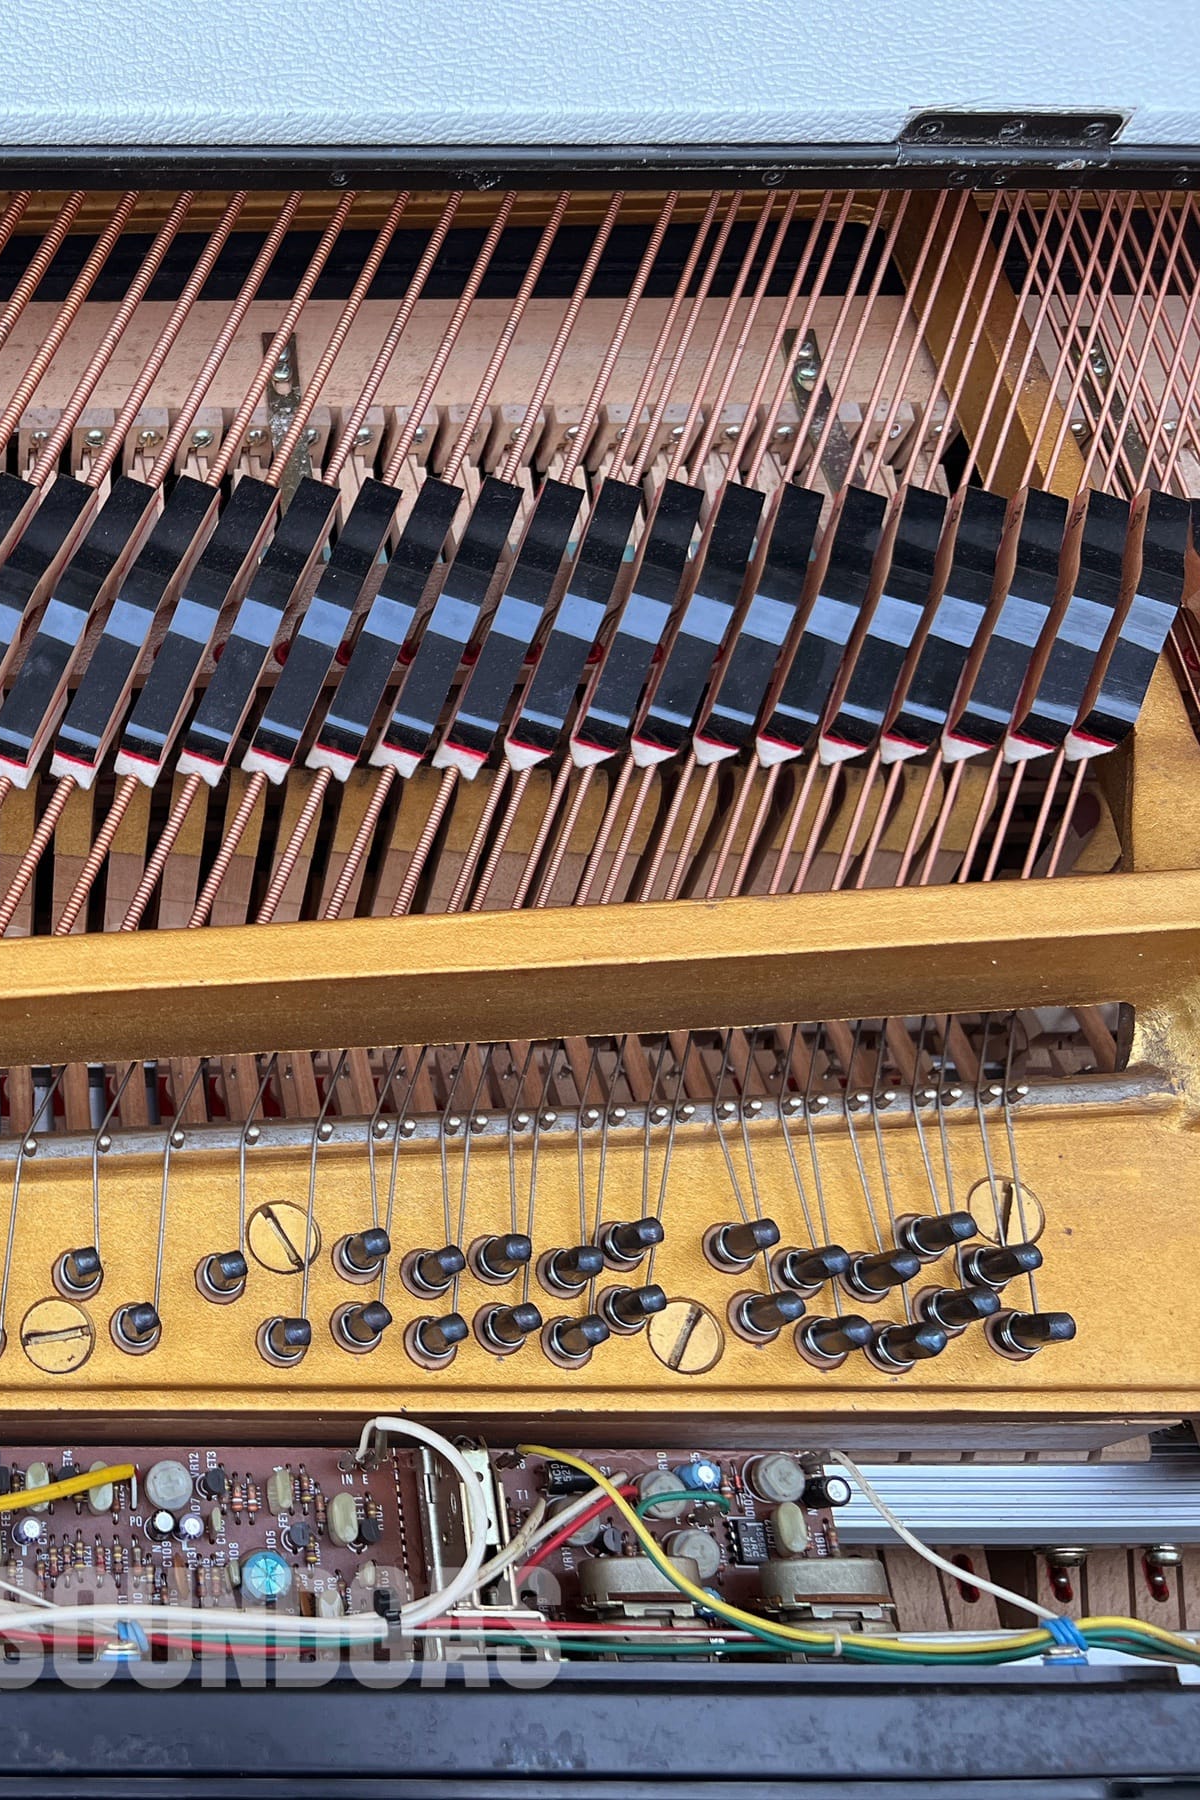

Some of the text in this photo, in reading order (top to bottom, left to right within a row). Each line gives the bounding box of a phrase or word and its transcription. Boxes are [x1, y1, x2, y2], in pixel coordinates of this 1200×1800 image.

[341, 1474, 353, 1485] IN
[362, 1474, 369, 1485] E
[161, 1541, 172, 1567] C109
[750, 1536, 760, 1558] JRC
